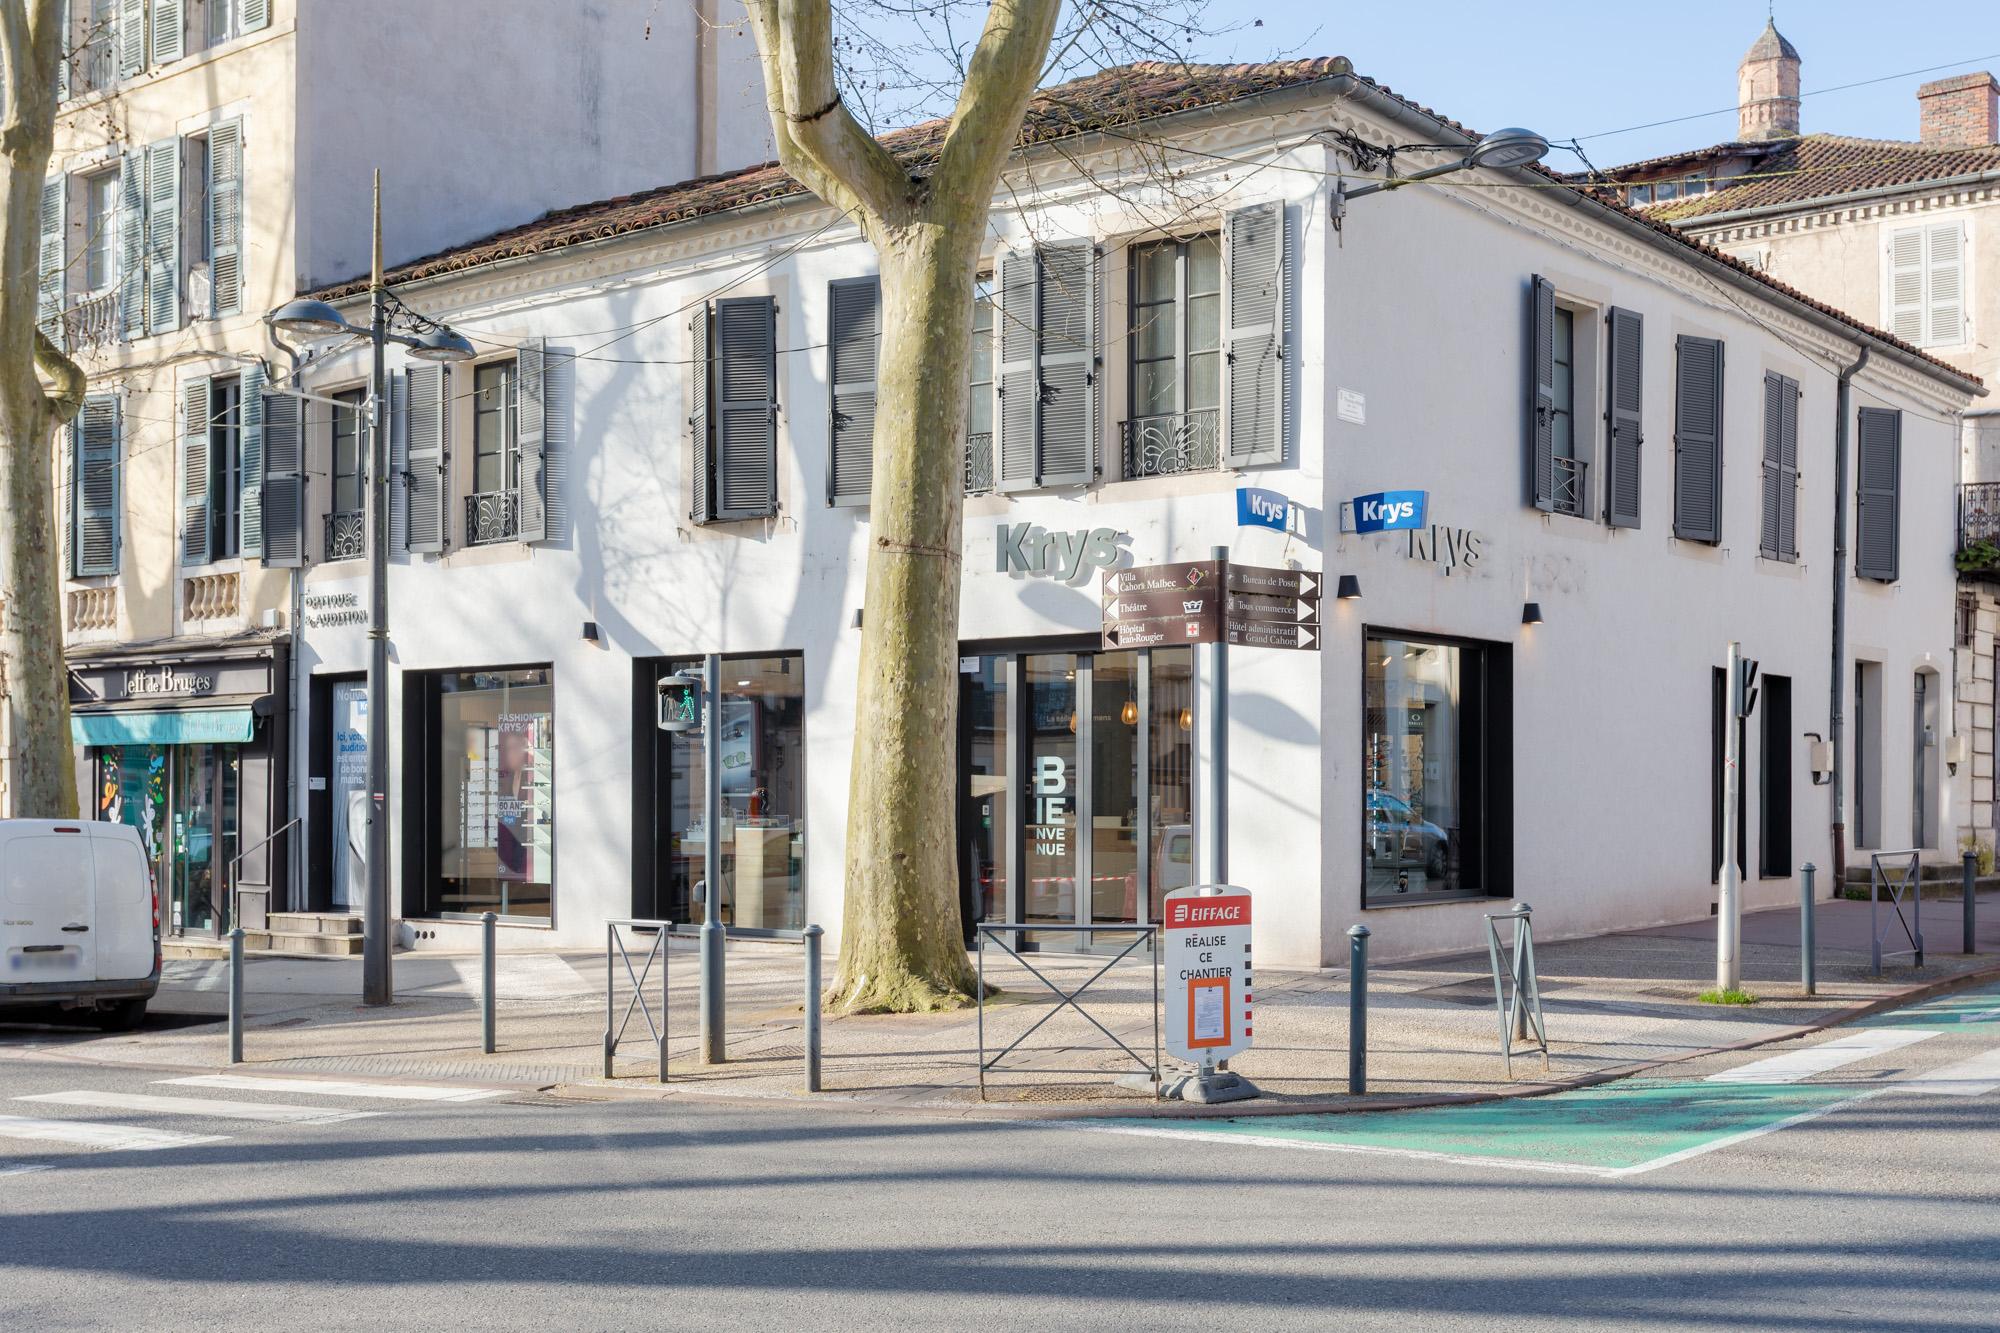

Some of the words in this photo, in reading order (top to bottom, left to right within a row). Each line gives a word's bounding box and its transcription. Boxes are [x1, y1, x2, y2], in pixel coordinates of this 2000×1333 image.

[1252, 495, 1283, 522] Krys
[1363, 501, 1414, 523] Krys
[996, 522, 1118, 581] Krys
[1119, 573, 1137, 581] Villa
[1242, 575, 1267, 585] Bureau
[1267, 577, 1277, 585] de
[1278, 578, 1297, 588] Poste
[1120, 582, 1145, 592] Cahors
[1147, 579, 1177, 589] Malbec
[1120, 603, 1147, 613] Théâtre
[1238, 600, 1254, 610] Tous
[1255, 604, 1297, 614] commerces
[1119, 623, 1145, 635] Hôpital
[1229, 621, 1247, 632] Hôtel
[1248, 624, 1297, 636] administratif
[1119, 632, 1165, 645] Jean-Rougier
[1245, 632, 1268, 643] Grand
[1269, 634, 1297, 646] Cahors
[120, 669, 146, 697] Jeff
[148, 682, 159, 692] de
[160, 666, 211, 694] Bruges
[336, 690, 367, 701] Nouve
[498, 713, 535, 722] FASHION
[340, 742, 367, 751] auditio
[1036, 798, 1066, 824] IE
[1036, 828, 1066, 840] NVE
[1036, 843, 1066, 856] NUE
[1191, 906, 1241, 921] EIFFAGE
[1199, 952, 1213, 963] CE
[1180, 967, 1232, 981] CHANTIER
